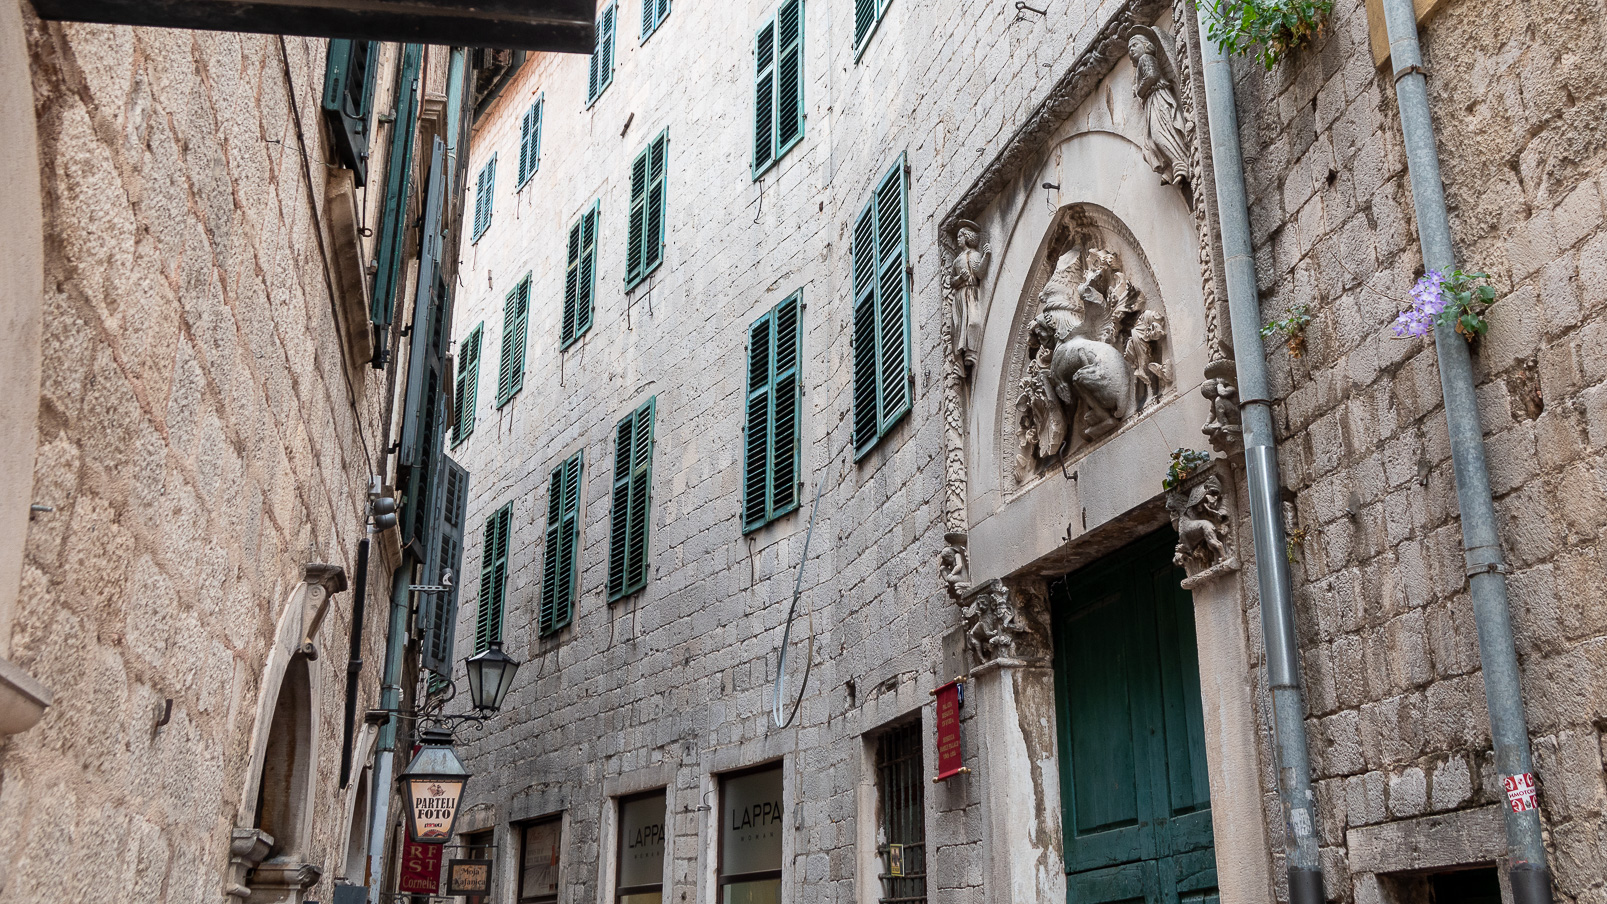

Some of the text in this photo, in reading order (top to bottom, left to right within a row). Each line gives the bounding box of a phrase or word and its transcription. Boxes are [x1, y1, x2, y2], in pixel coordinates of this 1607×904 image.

[415, 797, 456, 809] PARTELI
[417, 809, 451, 820] FOTO
[733, 800, 782, 831] LAPPA
[629, 824, 665, 848] LAPPA
[402, 875, 437, 890] Cornelia
